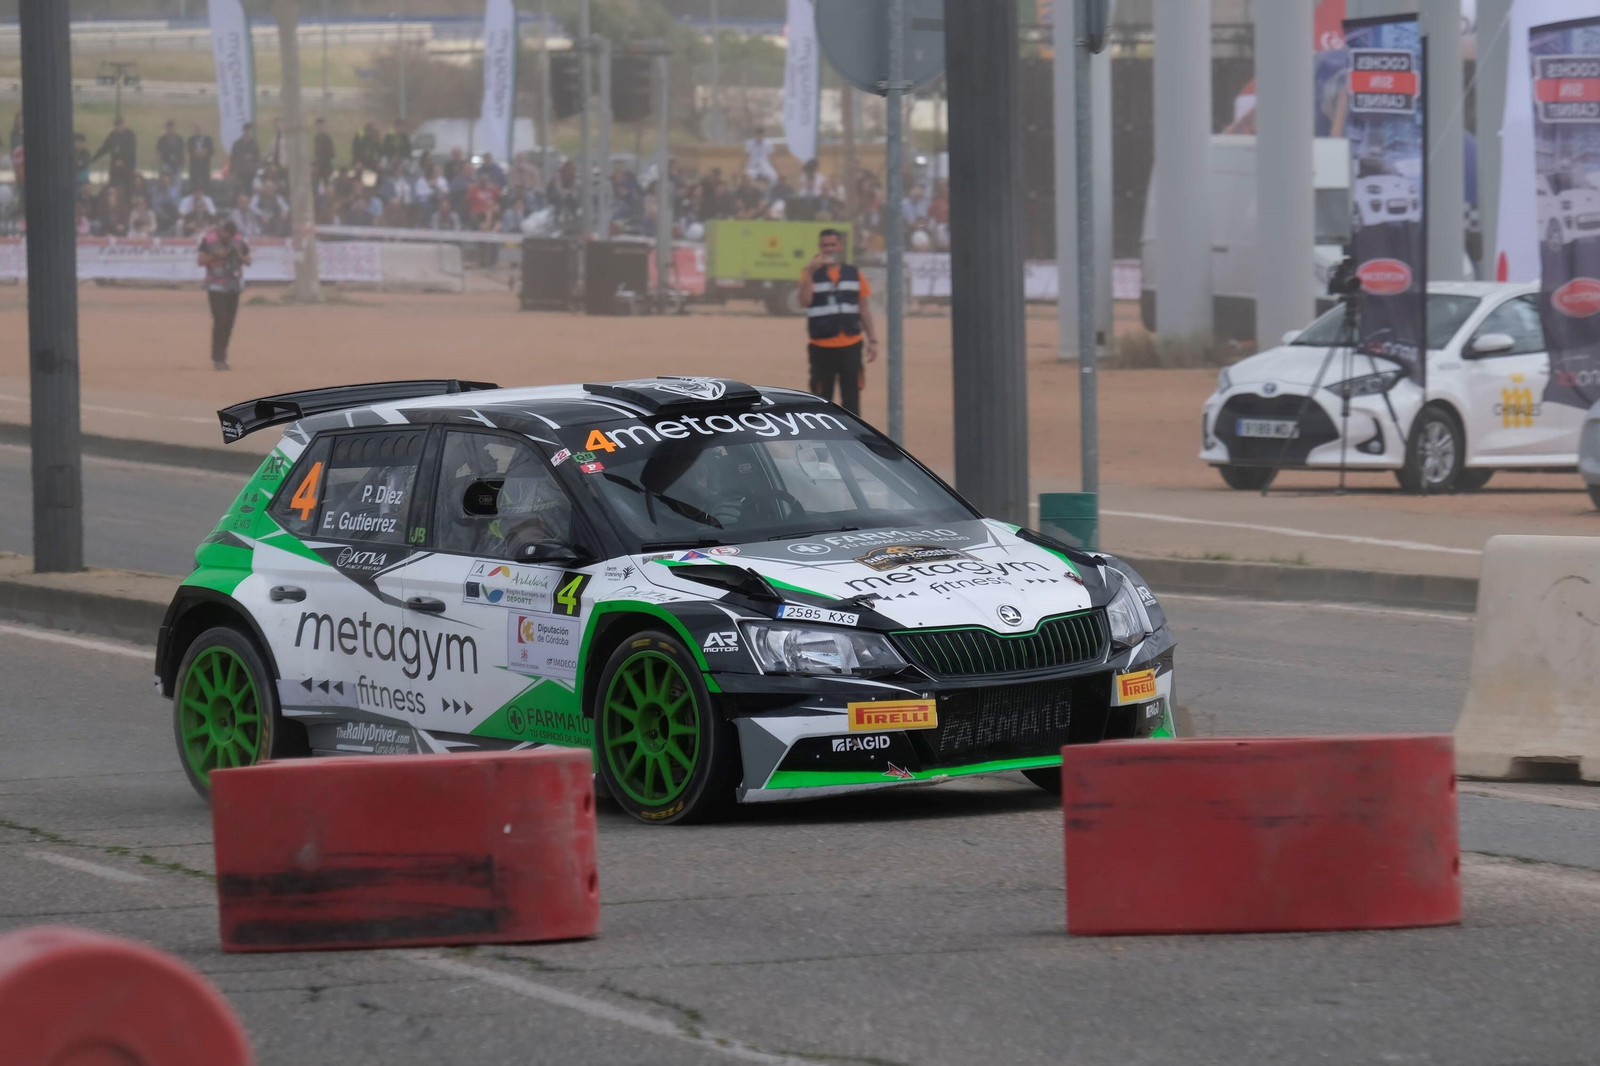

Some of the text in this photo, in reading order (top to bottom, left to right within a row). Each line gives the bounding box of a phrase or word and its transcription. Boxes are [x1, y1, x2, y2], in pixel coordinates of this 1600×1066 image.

[585, 429, 617, 453] 4
[604, 412, 848, 449] metagym
[290, 461, 323, 521] 4
[361, 485, 373, 503] P.
[323, 511, 397, 533] E. Gutierrez
[824, 528, 958, 546] FARMA10
[859, 537, 911, 547] ESPACIO
[843, 560, 1051, 592] metagym
[929, 576, 1012, 594] fitness
[506, 596, 532, 605] DEPORTE
[557, 575, 584, 615] 4
[786, 607, 855, 624] 2585 KXS
[537, 623, 569, 636] Diputación
[537, 634, 569, 646] de Córdoba
[703, 631, 738, 647] AR
[294, 611, 479, 682] metagym
[357, 674, 426, 715] fitness
[1121, 674, 1155, 697] PIRELLI
[526, 707, 590, 735] FARMA10
[854, 704, 930, 725] PIRELLI
[336, 722, 410, 745] TheRallyDriver.com
[940, 699, 1071, 752] FARMA10
[529, 728, 592, 747] TU ESPACIO DE SALUD
[845, 735, 891, 751] PAGID
